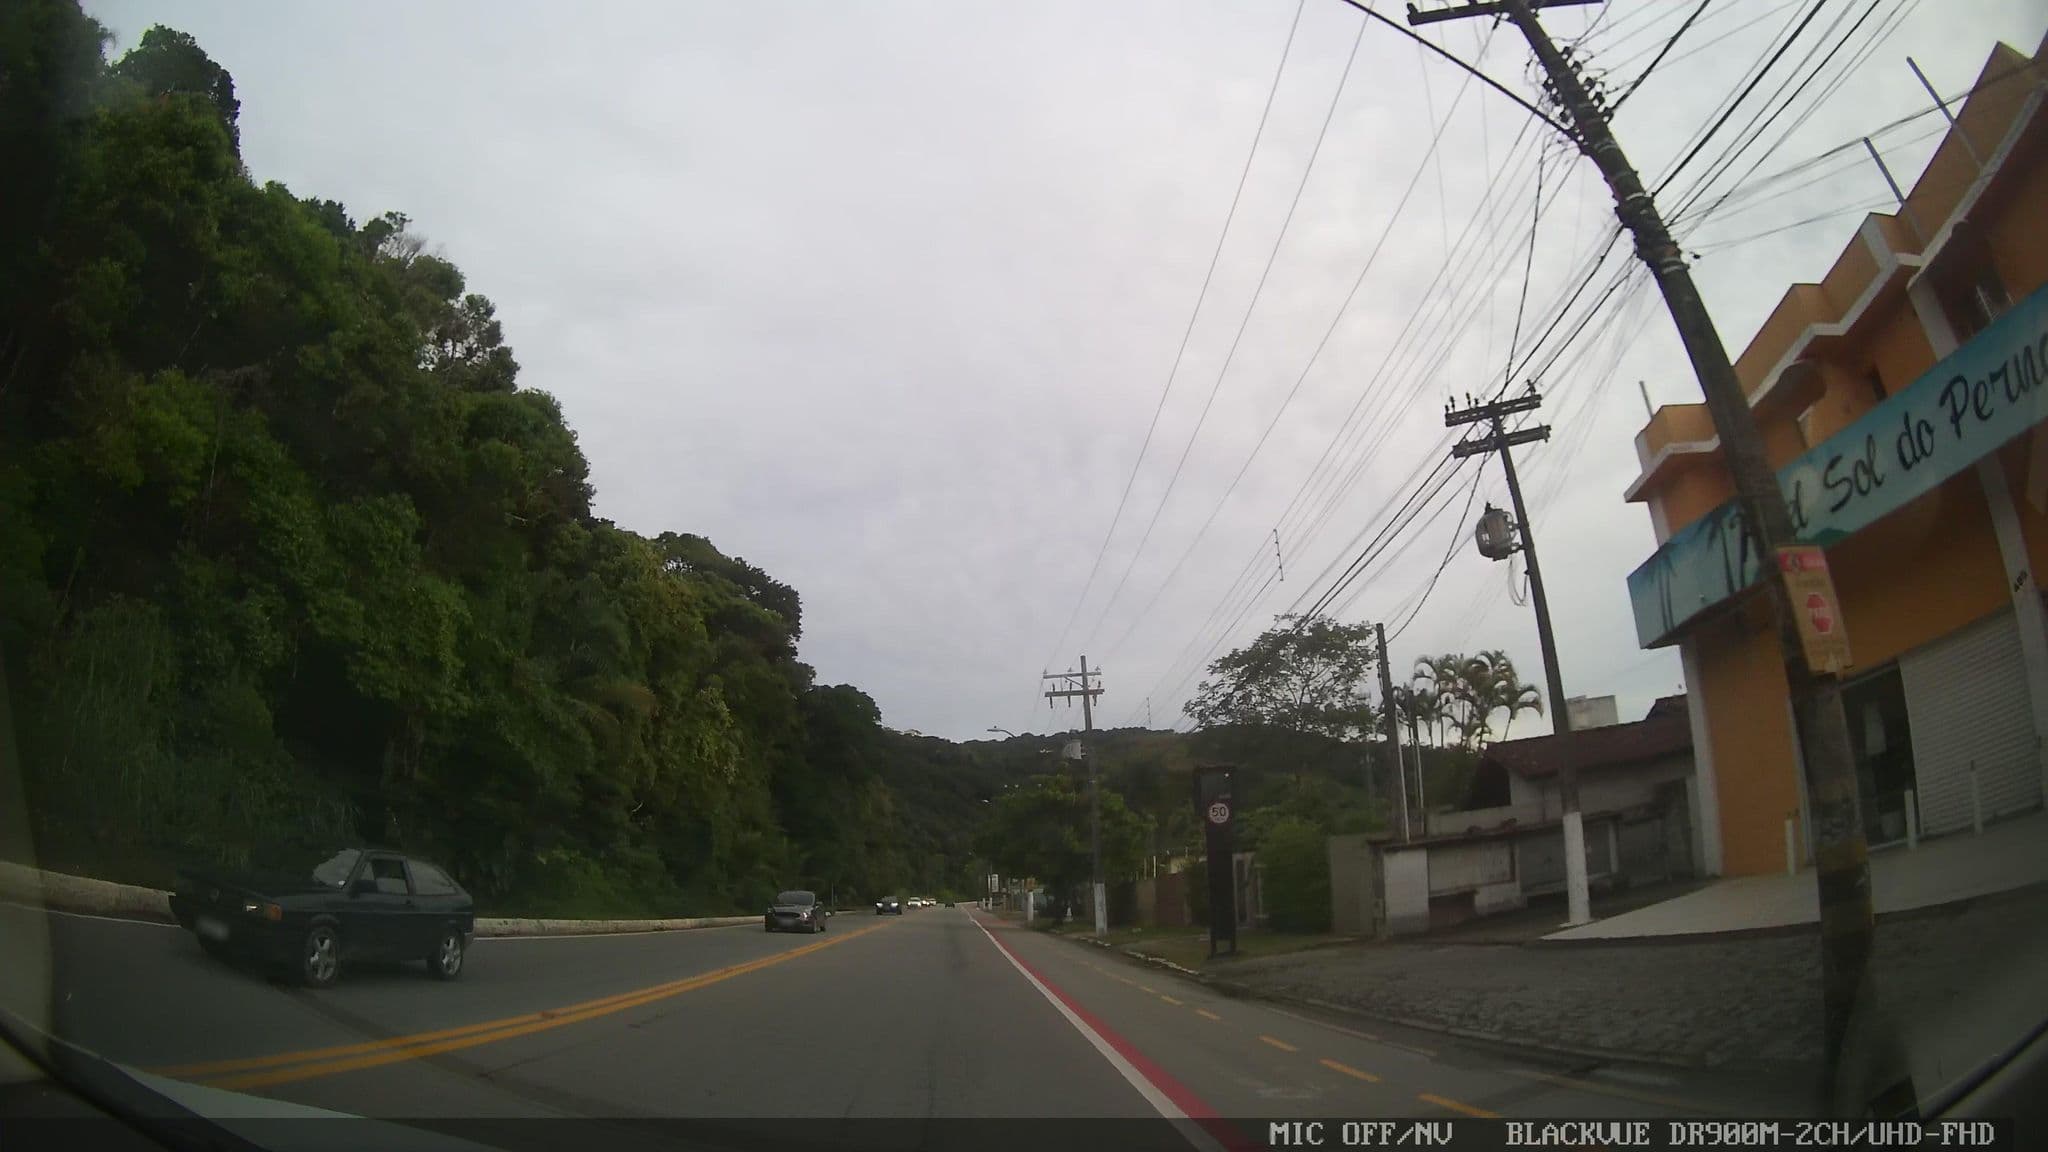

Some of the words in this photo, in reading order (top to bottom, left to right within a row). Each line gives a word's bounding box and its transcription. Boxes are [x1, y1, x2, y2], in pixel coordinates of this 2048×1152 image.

[1823, 434, 1884, 512] Sol
[1896, 411, 1935, 471] do
[1211, 806, 1227, 817] 50
